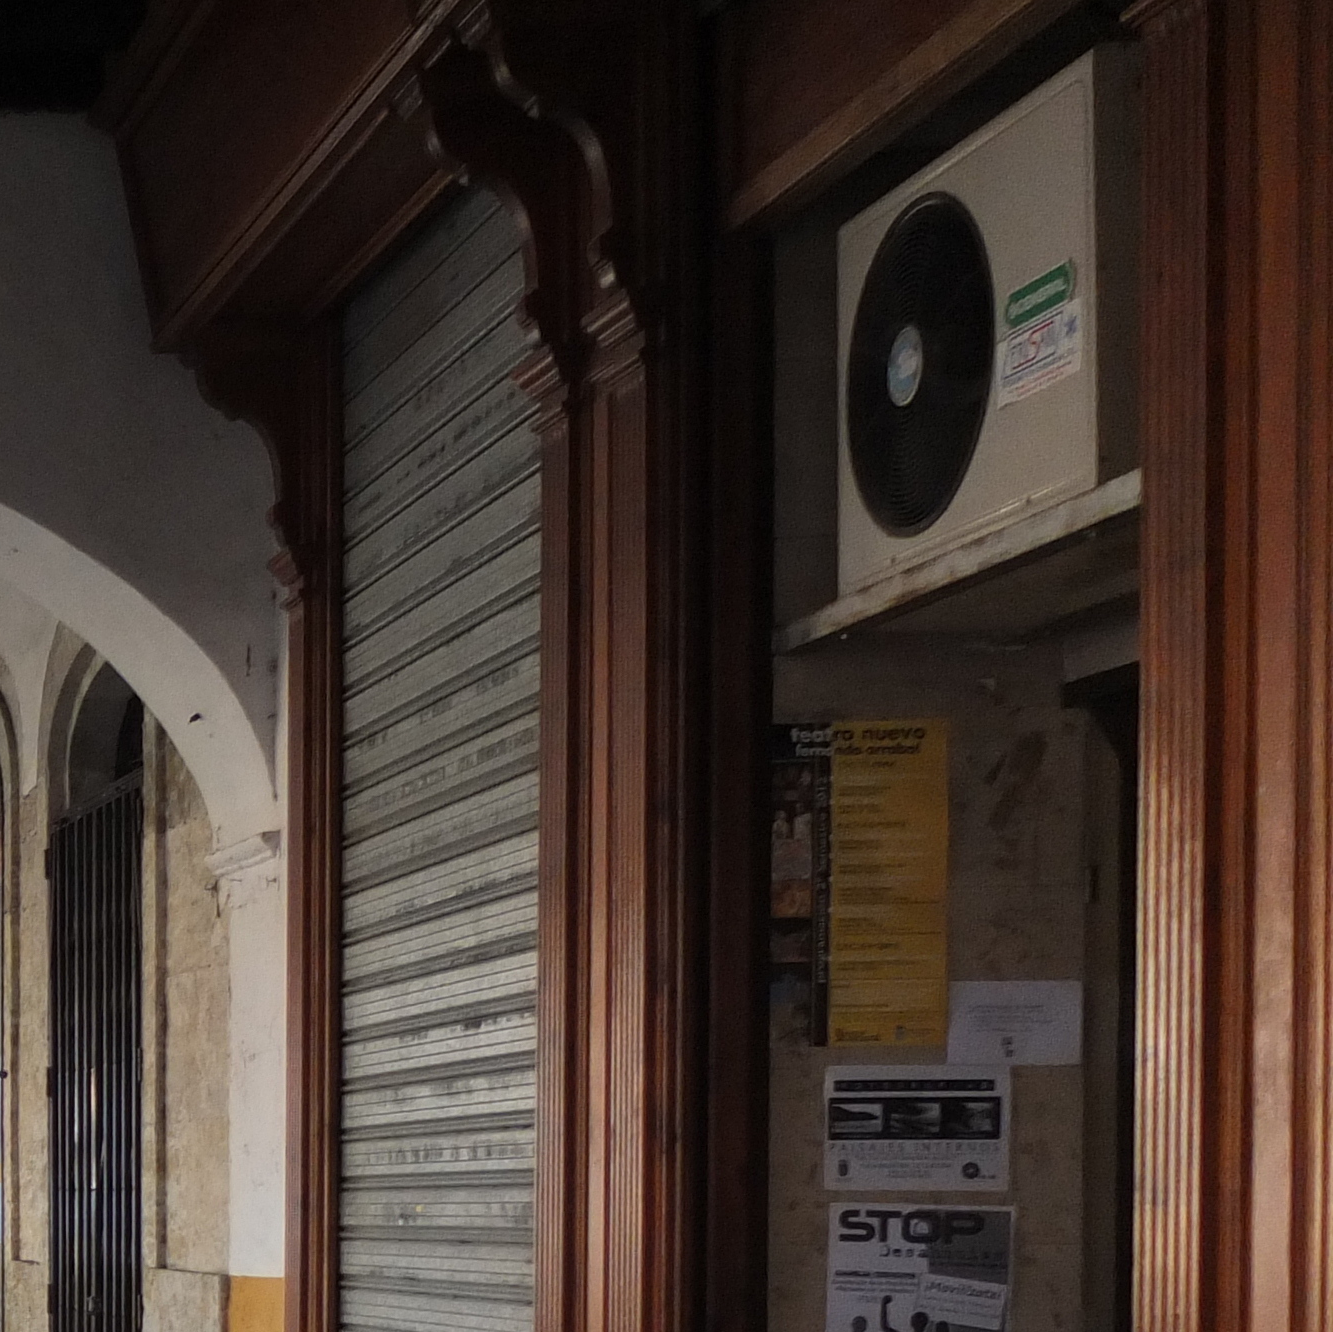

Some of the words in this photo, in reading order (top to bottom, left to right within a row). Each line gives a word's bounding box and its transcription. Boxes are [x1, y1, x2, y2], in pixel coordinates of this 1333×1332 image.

[790, 727, 854, 743] teatro
[862, 727, 926, 741] nuevo
[914, 1142, 1000, 1153] INTERNOS
[839, 1209, 985, 1244] STOP
